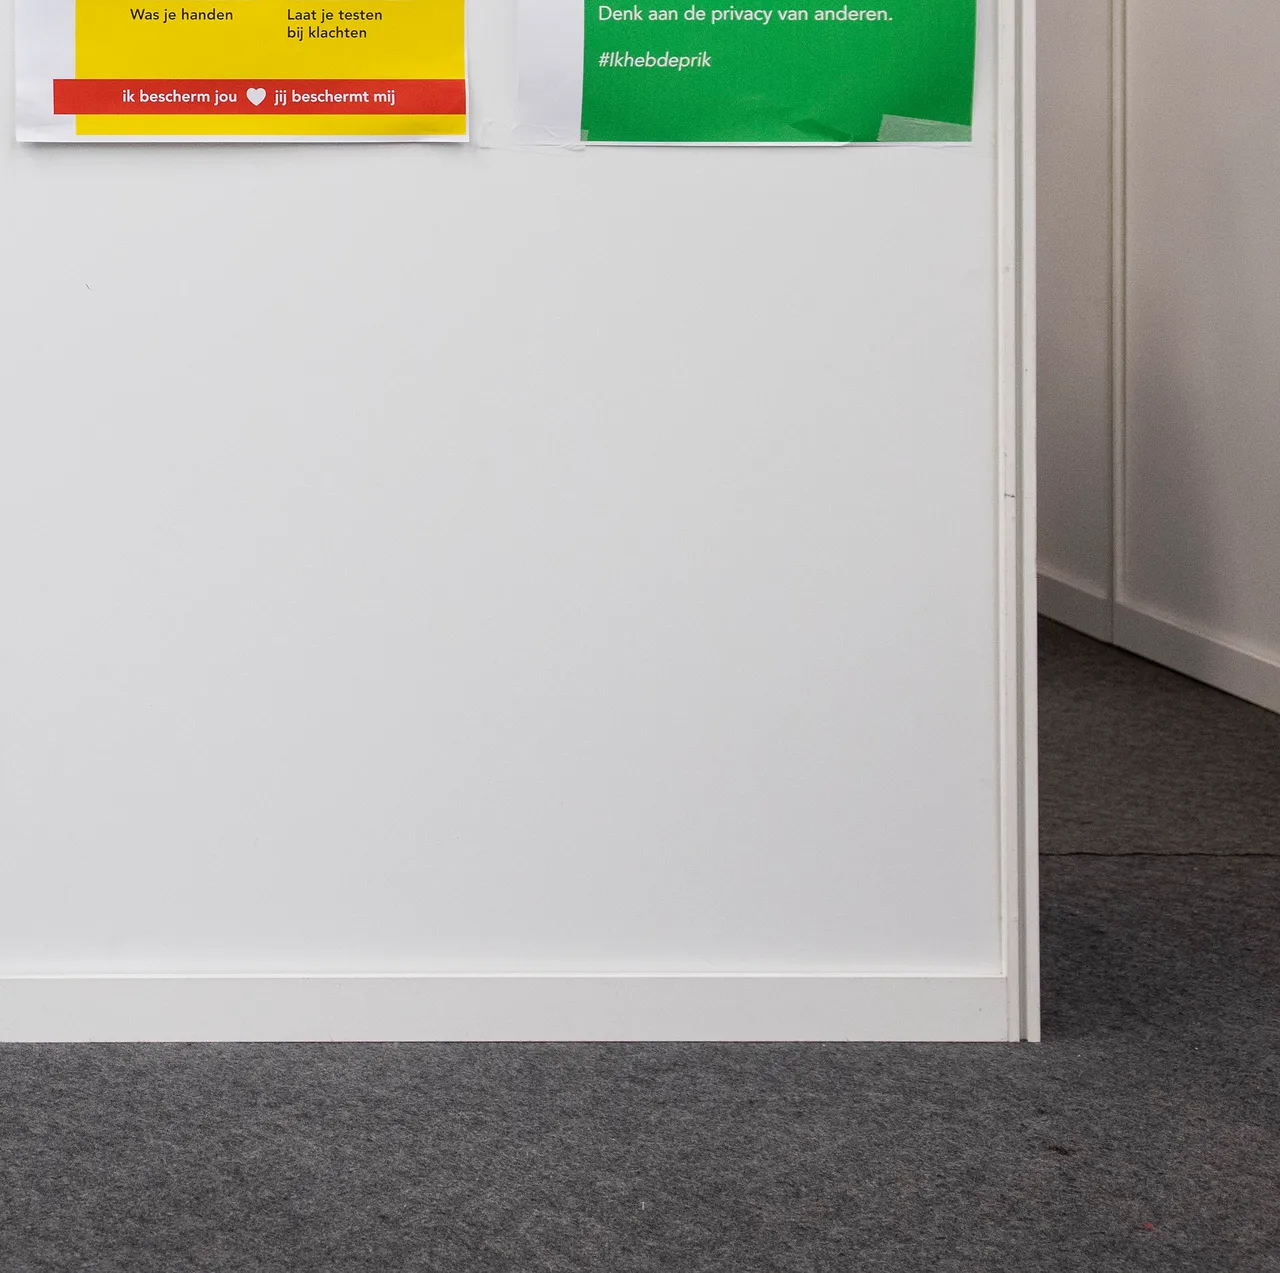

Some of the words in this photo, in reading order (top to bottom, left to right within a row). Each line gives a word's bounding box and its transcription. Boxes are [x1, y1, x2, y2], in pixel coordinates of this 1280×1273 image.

[130, 9, 159, 20] Was
[163, 9, 176, 23] je
[182, 8, 232, 20] handen
[288, 9, 316, 20] Laat
[321, 9, 333, 23] je
[339, 11, 382, 20] testen
[599, 5, 643, 20] Denk
[649, 10, 678, 20] aan
[684, 5, 705, 20] de
[712, 6, 772, 25] privacy
[778, 10, 808, 20] van
[815, 5, 892, 20] anderen.
[288, 26, 303, 41] bij
[309, 26, 366, 38] klachten
[599, 51, 711, 71] #Ikhebdeprik
[123, 89, 135, 102] ik
[140, 89, 210, 102] bescherm
[214, 90, 236, 105] jou
[274, 90, 286, 105] jij
[292, 90, 369, 102] beschermt
[374, 90, 395, 105] mij
